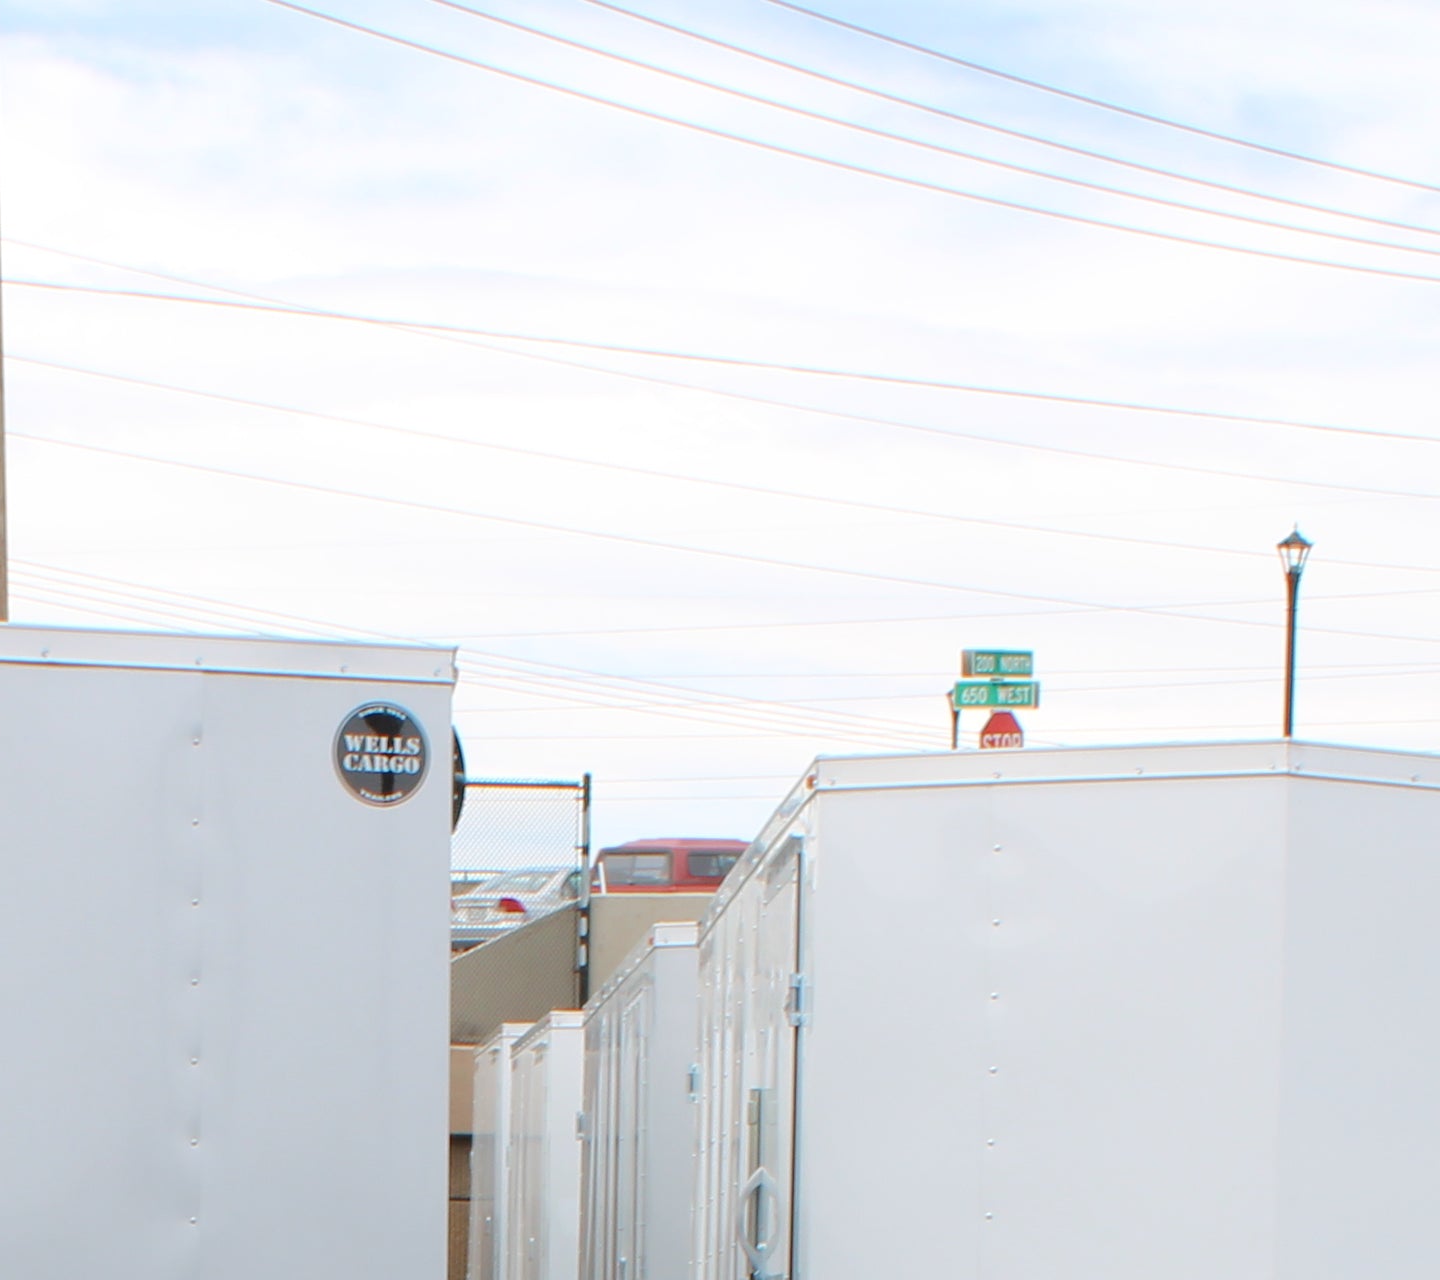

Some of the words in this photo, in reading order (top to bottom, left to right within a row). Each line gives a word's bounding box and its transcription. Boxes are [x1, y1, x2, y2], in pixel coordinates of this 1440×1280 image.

[975, 655, 995, 672] 200
[961, 686, 988, 704] 650
[997, 686, 1030, 704] WEST
[344, 734, 421, 756] WELLS
[343, 753, 421, 775] CARGO
